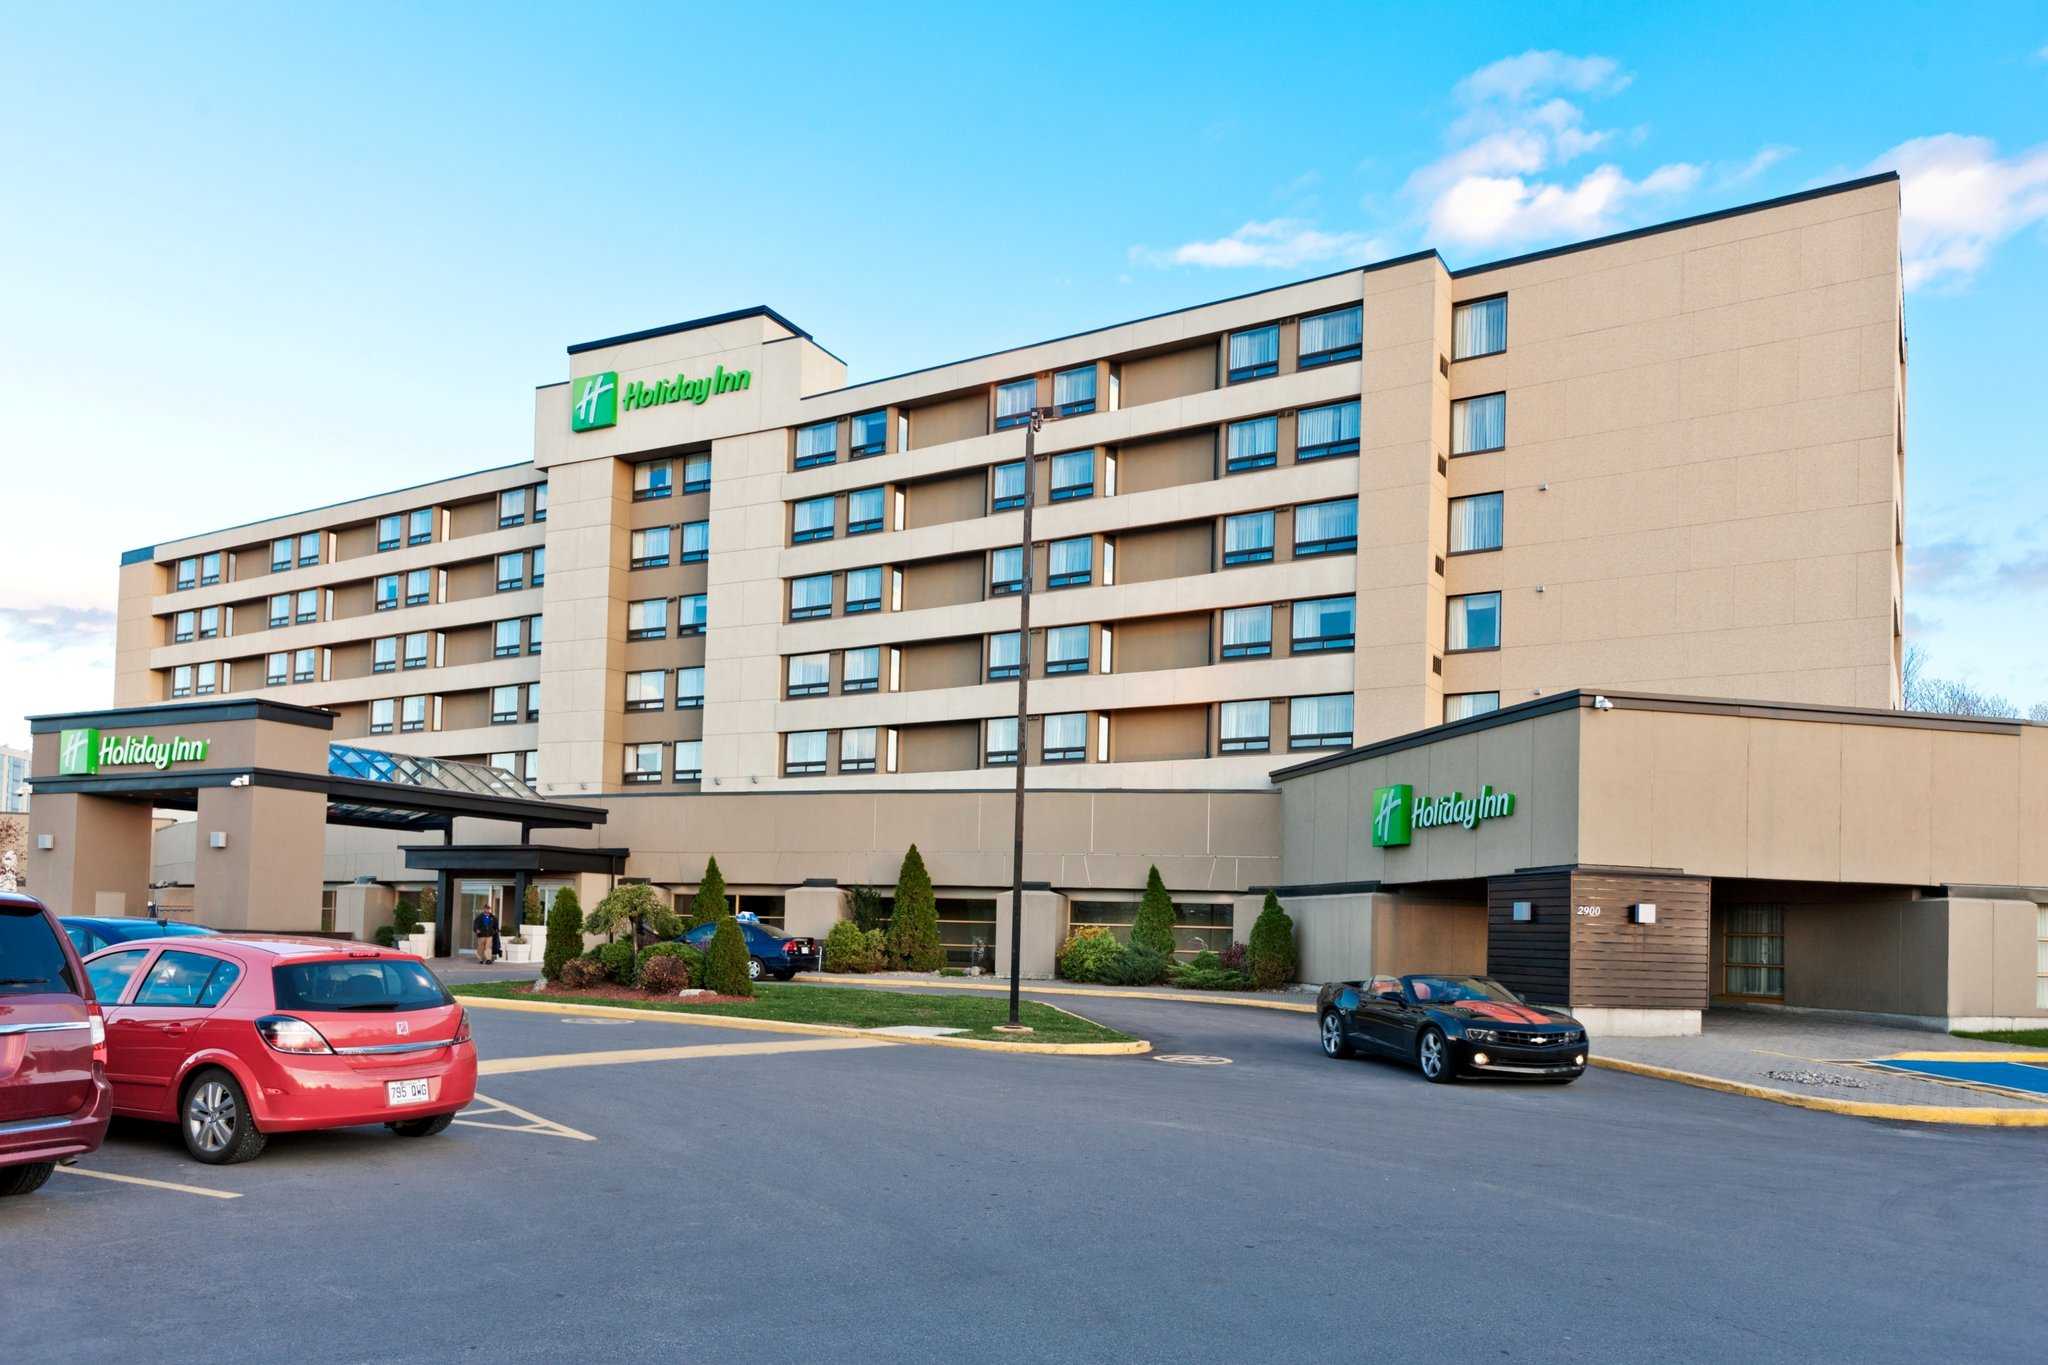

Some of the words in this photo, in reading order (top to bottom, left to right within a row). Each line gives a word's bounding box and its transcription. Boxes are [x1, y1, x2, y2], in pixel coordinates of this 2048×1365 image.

[622, 373, 712, 412] Holiday
[712, 363, 752, 396] Inn
[98, 735, 169, 770] Holiday
[171, 736, 207, 762] Inn
[1411, 792, 1477, 830] Holiday
[1478, 784, 1511, 819] Inn
[1576, 905, 1601, 917] 2900
[391, 1086, 407, 1099] 795
